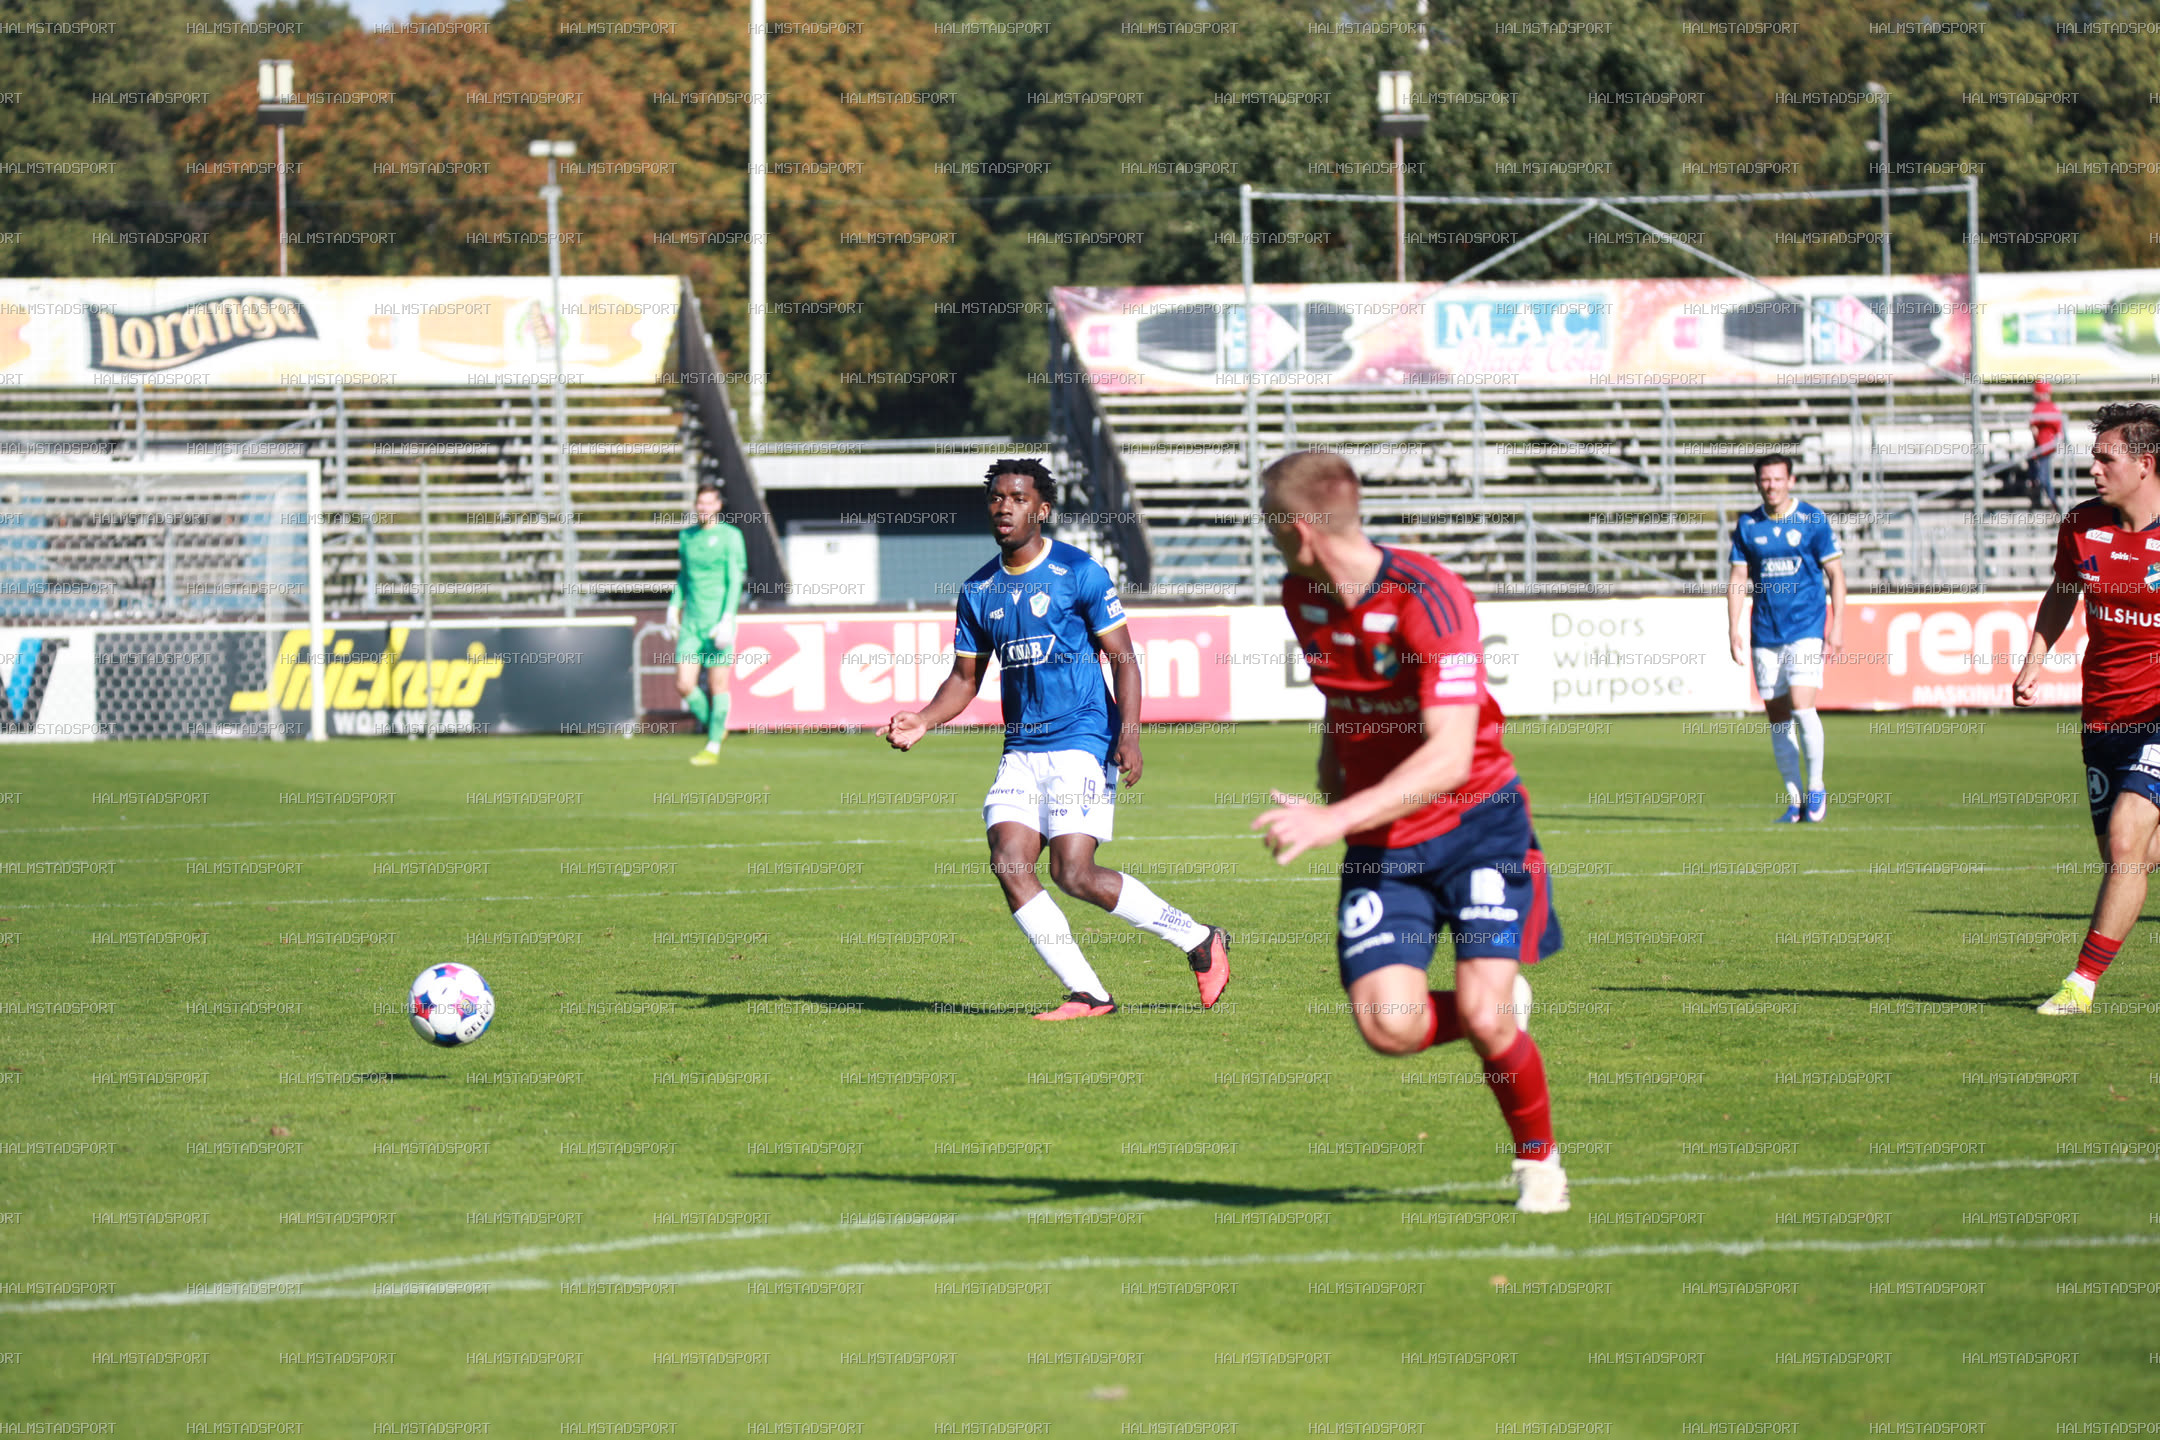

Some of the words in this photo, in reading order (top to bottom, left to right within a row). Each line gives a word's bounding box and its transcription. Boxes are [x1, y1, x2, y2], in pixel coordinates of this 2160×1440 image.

[98, 296, 306, 369] Loranga
[1552, 612, 1644, 637] Doors
[2086, 600, 2160, 628] MILSHUS
[1554, 642, 1621, 669] with
[230, 628, 504, 711] Snickers
[2129, 764, 2160, 780] BALC
